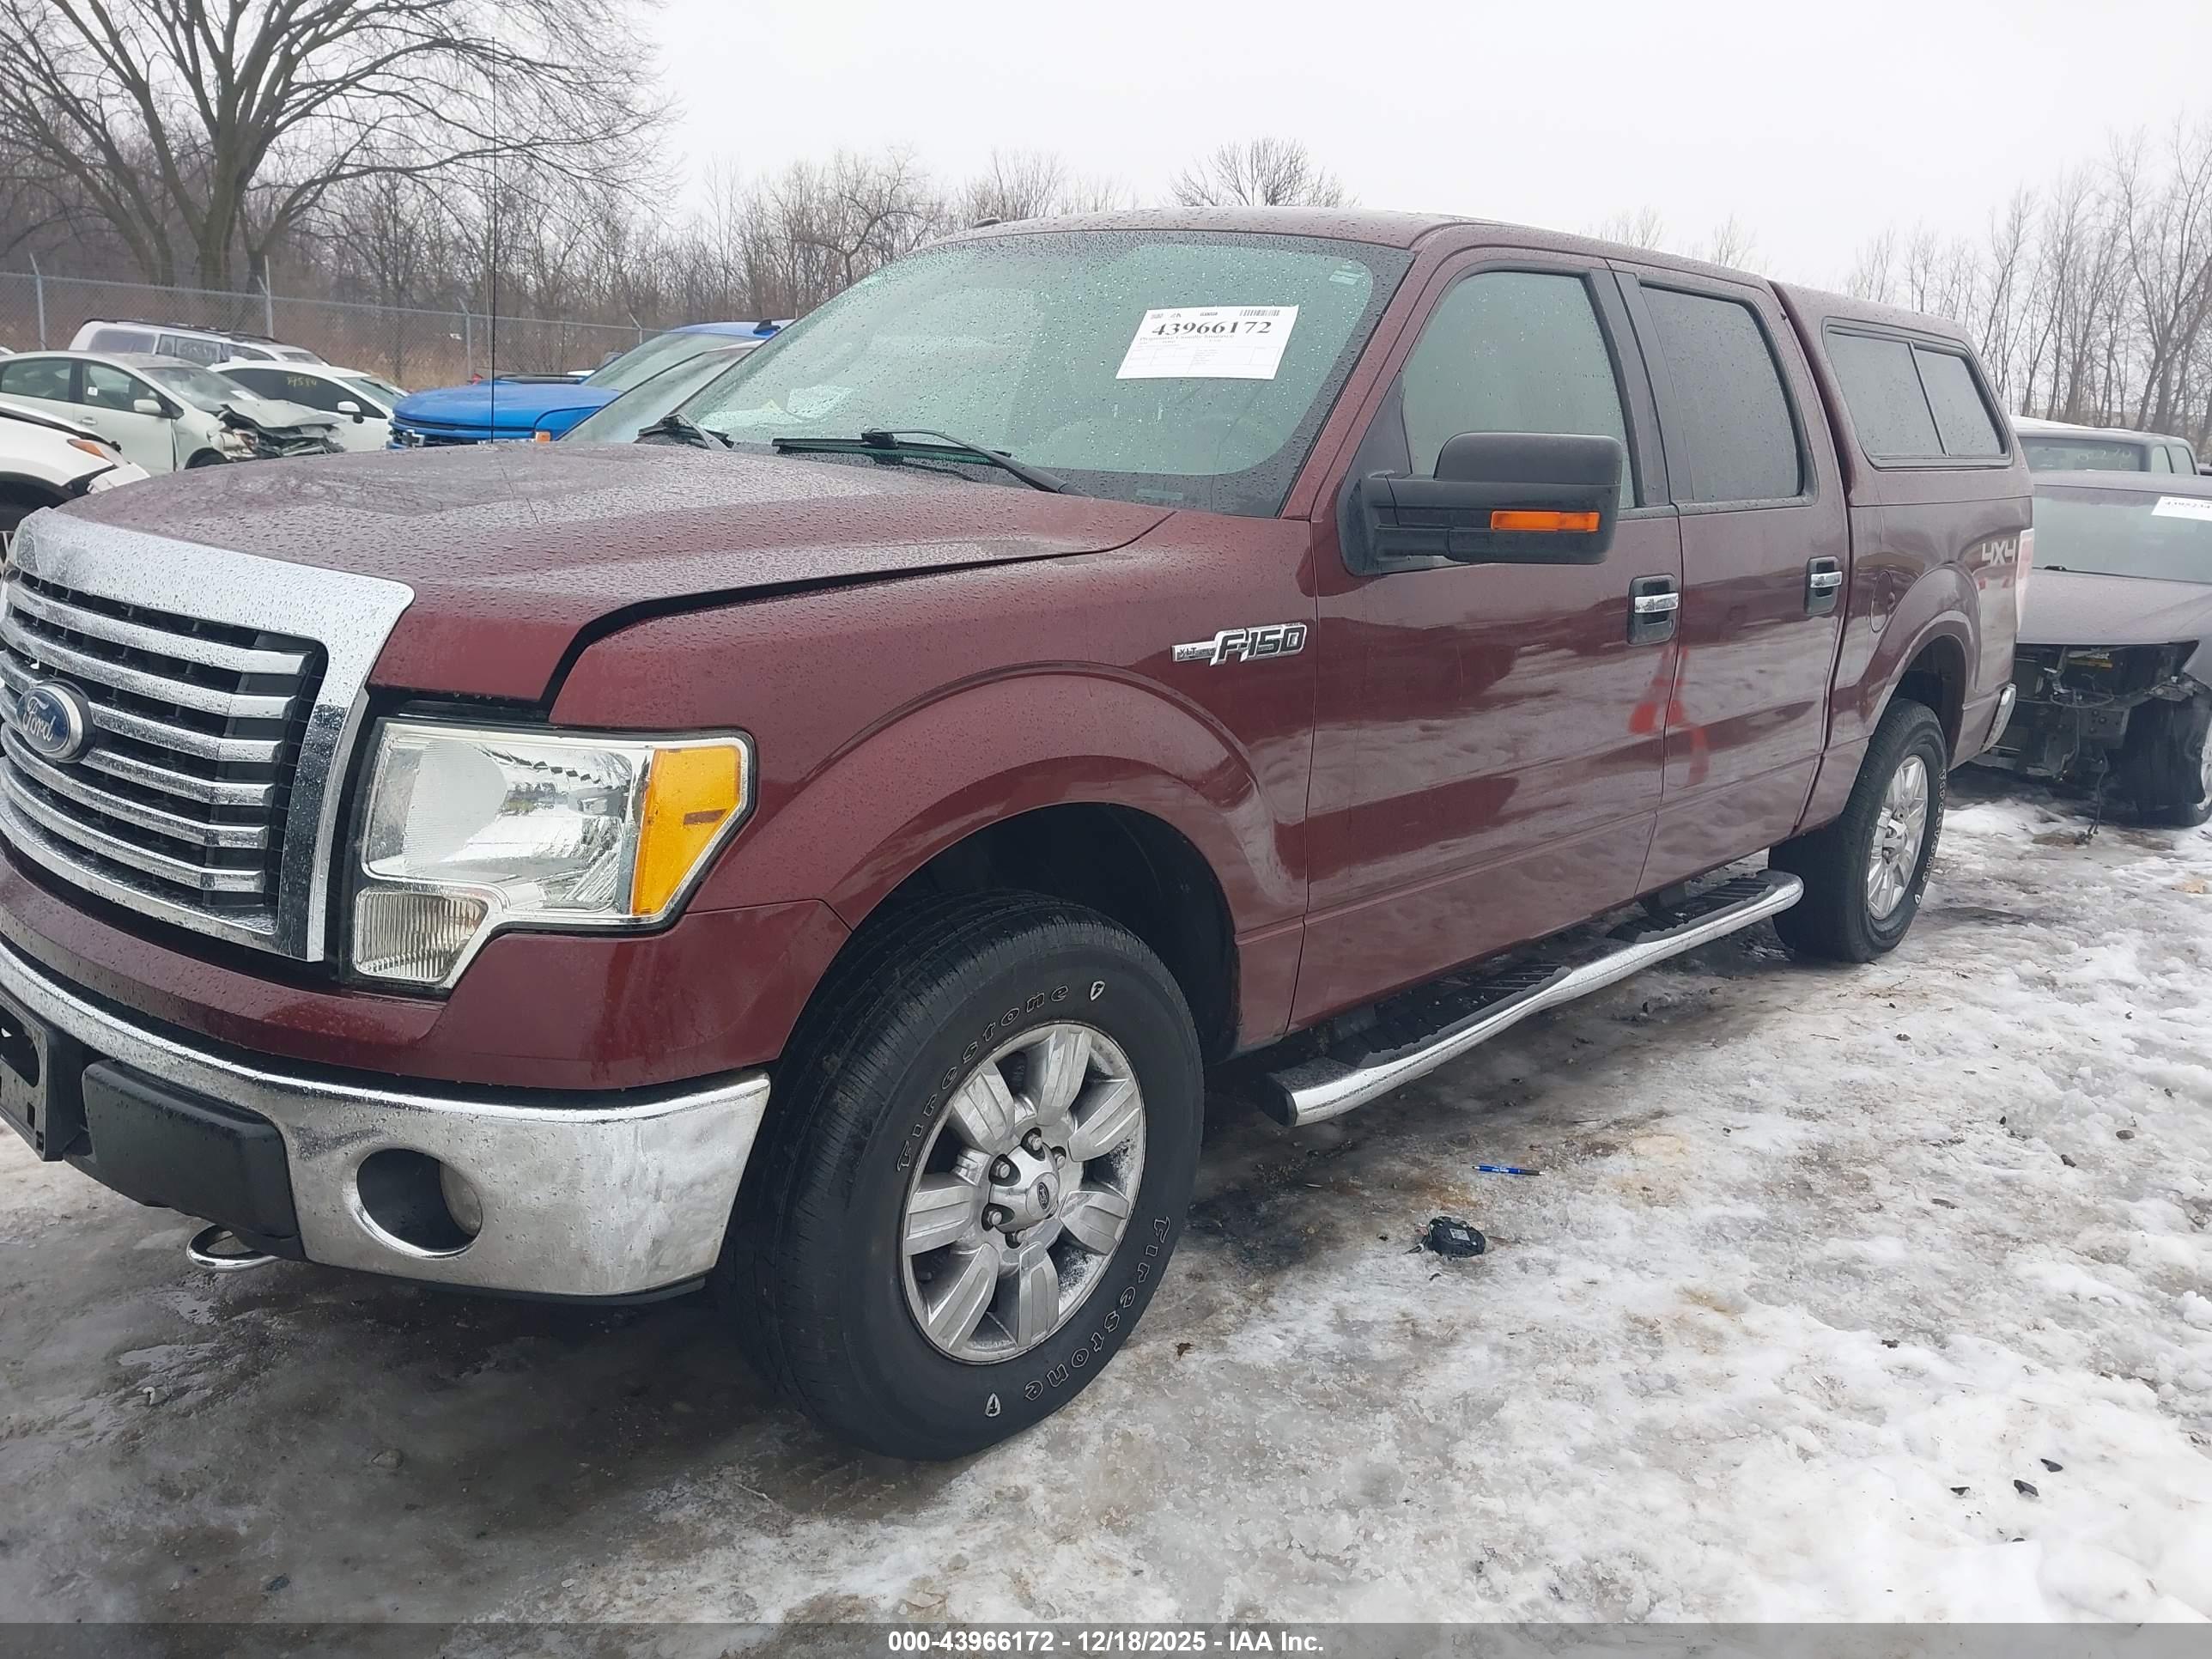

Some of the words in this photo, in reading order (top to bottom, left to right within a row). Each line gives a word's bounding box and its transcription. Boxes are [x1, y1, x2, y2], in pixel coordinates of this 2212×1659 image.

[1152, 320, 1272, 336] 43966172
[1210, 623, 1307, 666] F-150
[22, 696, 57, 742] Ford
[896, 984, 1069, 1171] Firestone
[1024, 1216, 1171, 1401] Firestone
